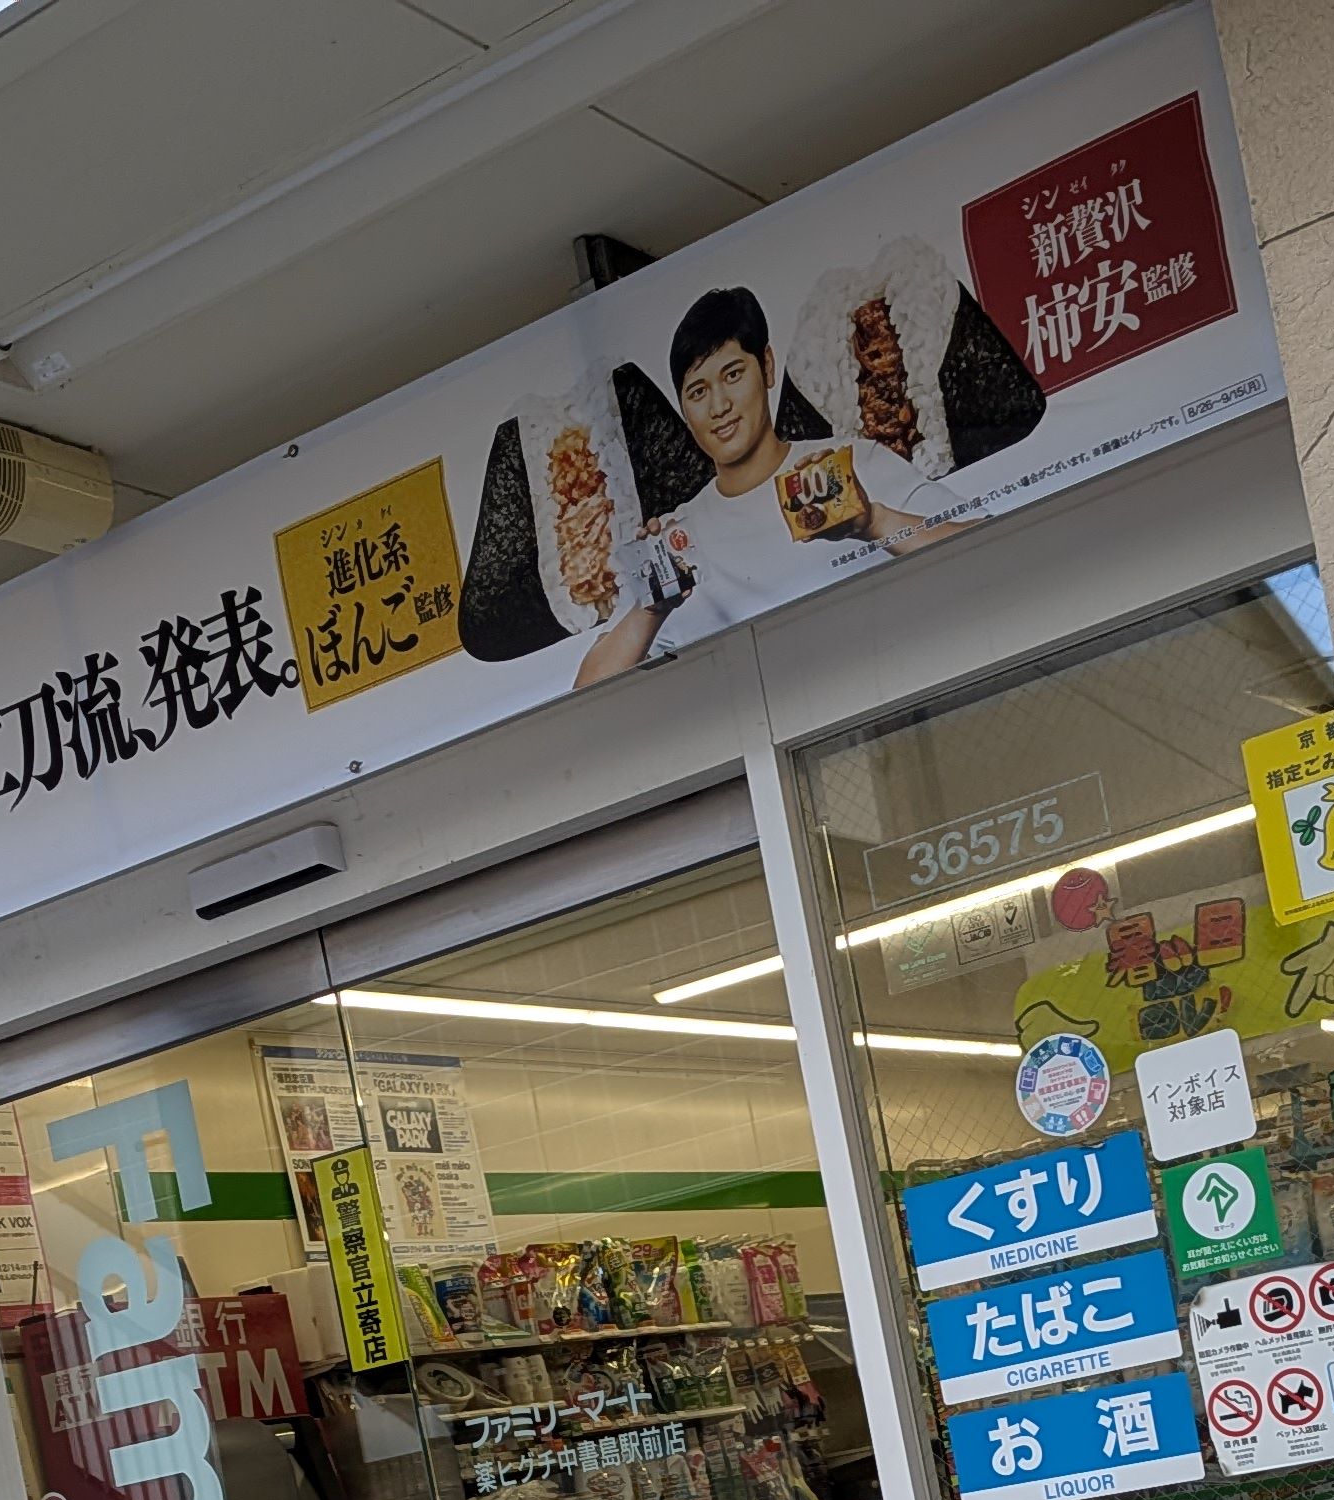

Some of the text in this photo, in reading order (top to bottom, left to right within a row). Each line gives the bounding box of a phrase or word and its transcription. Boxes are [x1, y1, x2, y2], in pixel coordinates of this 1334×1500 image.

[1022, 184, 1059, 220] シン
[1028, 178, 1152, 279] 新贅沢
[1021, 252, 1199, 375] 柿安 監修
[320, 517, 348, 549] シン
[324, 522, 410, 598] 進化系
[305, 575, 455, 687] ぼんご 監修
[907, 796, 1066, 889] 36575
[1146, 1064, 1242, 1105] インボイス
[1168, 1090, 1227, 1123] 対象店
[386, 1109, 433, 1130] GALAXY
[395, 1127, 432, 1150] PARK
[947, 1154, 1103, 1240] くすり
[990, 1234, 1080, 1271] MEDICINE
[1182, 1243, 1279, 1272] お気軽にお知らせください
[1187, 1233, 1269, 1259] 耳が聞こえにくい方は
[335, 1199, 388, 1365] 警察官立寄店
[175, 1301, 247, 1348] 銀行
[967, 1276, 1135, 1362] たばこ
[1007, 1350, 1113, 1388] CIGARETTE
[465, 1382, 654, 1449] ファミリーマート
[988, 1391, 1160, 1475] お酒
[474, 1421, 687, 1495] 薬ヒグチ中書島駅前店
[1044, 1473, 1116, 1500] LIQUOR
